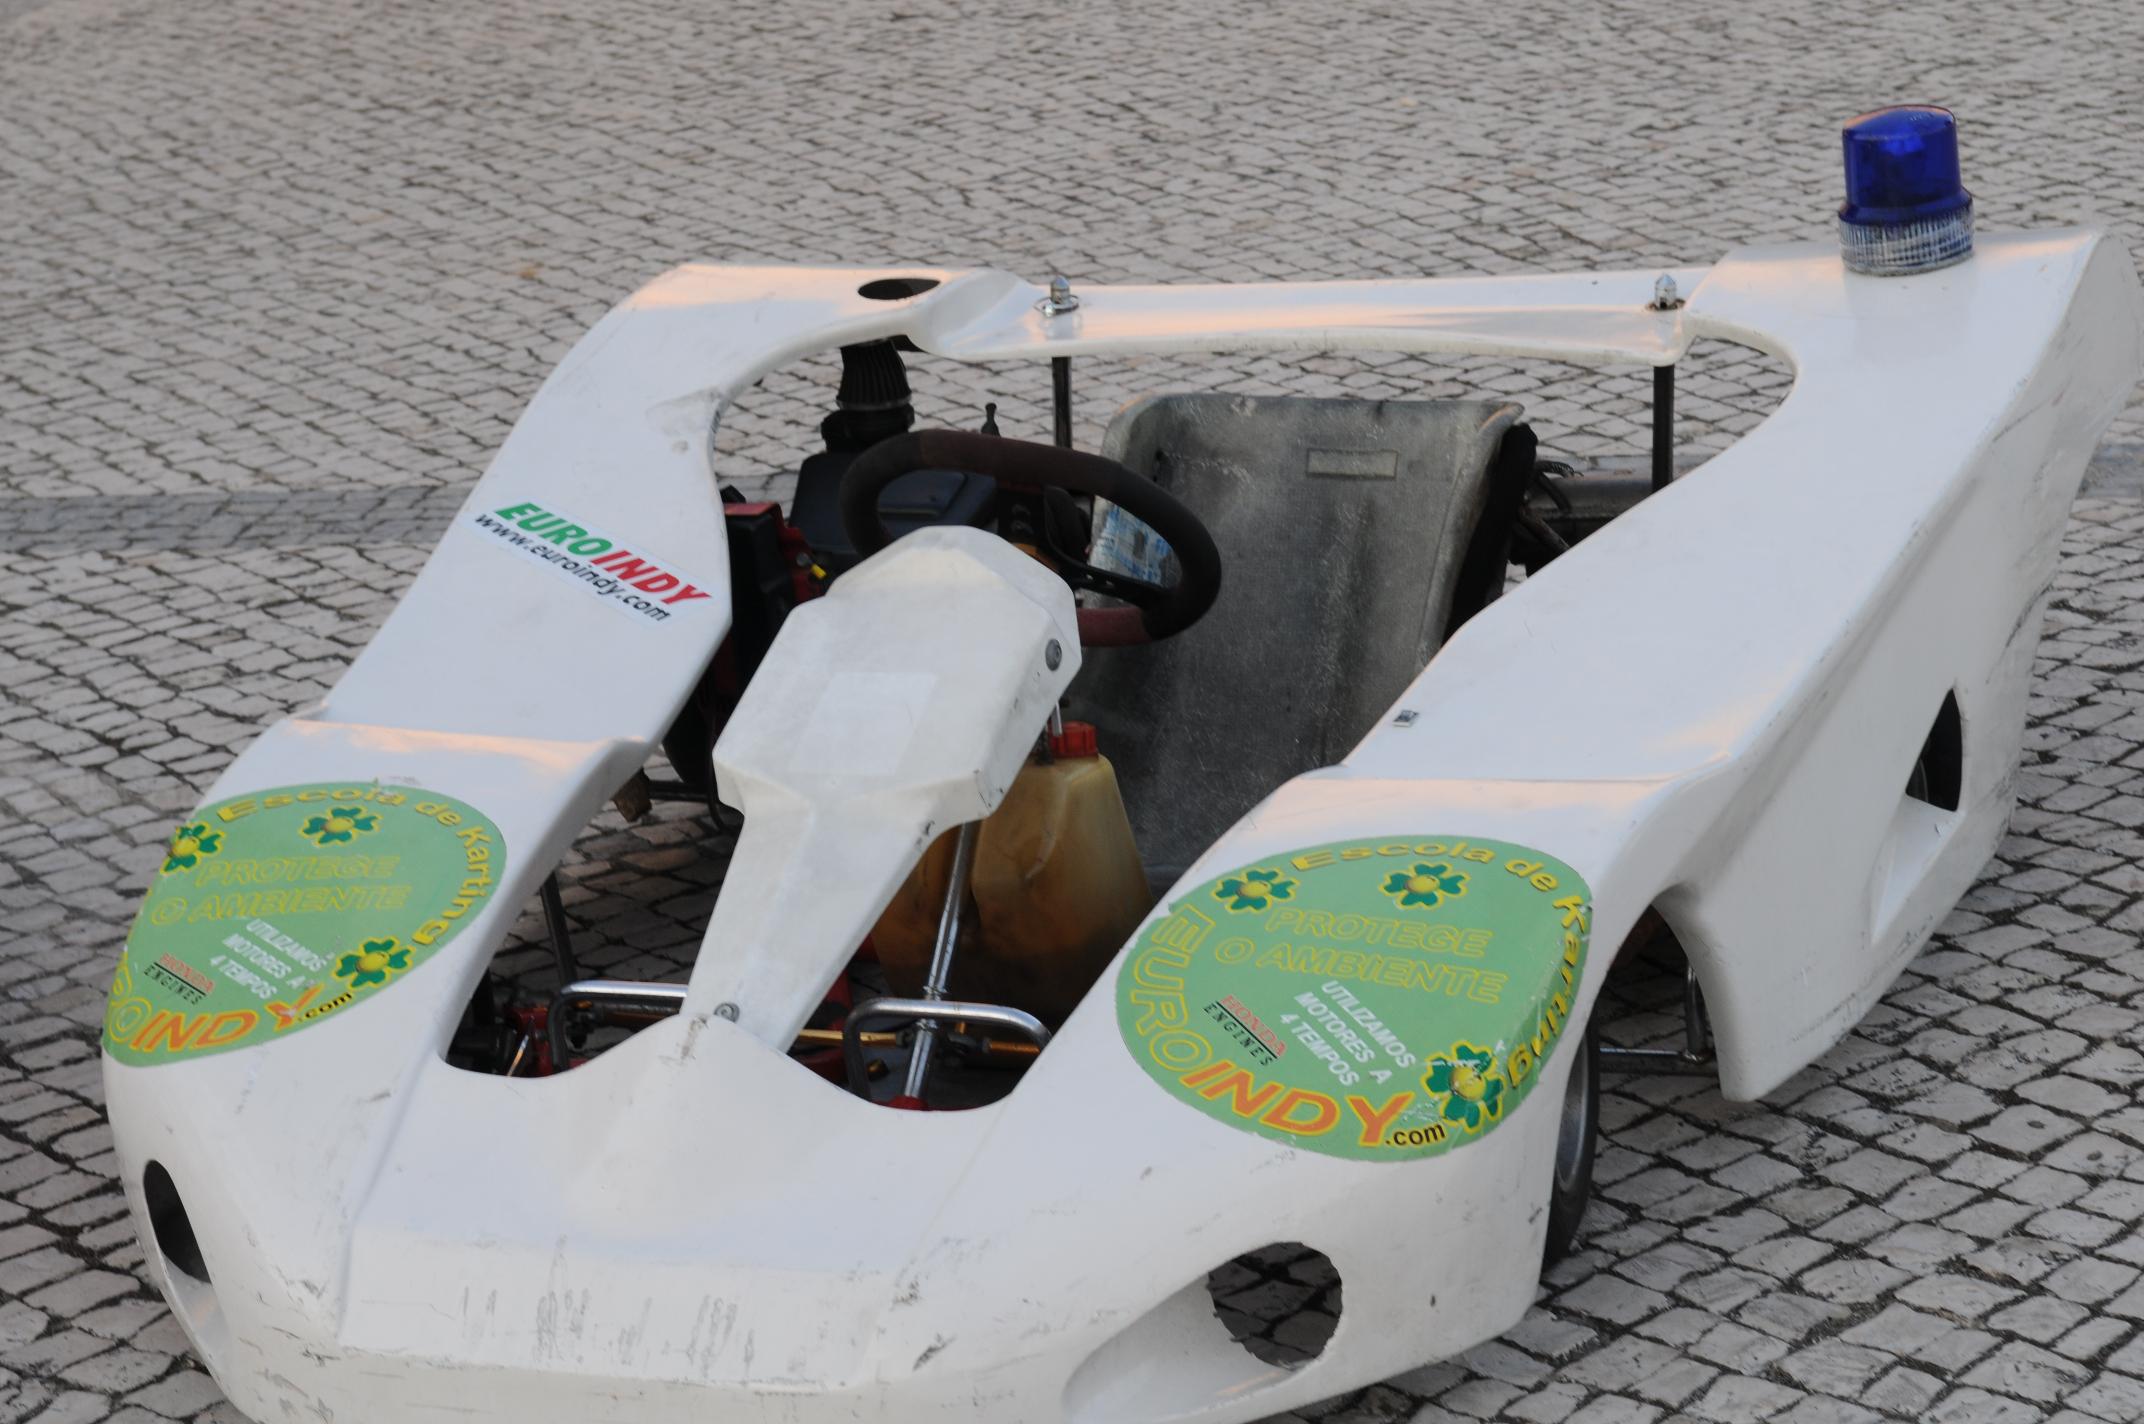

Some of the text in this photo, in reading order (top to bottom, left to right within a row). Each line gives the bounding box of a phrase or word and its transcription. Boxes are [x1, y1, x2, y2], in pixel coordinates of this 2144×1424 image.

[475, 514, 671, 621] www.euroindy.com
[195, 854, 402, 888] PROTEGE
[216, 786, 493, 945] Escola de Karting
[150, 885, 412, 926] O AMBIENTE
[1264, 906, 1496, 958] PROTEGE
[210, 954, 277, 999] 4 TEMPOS
[223, 933, 292, 979] MOTORES
[246, 918, 327, 972] UTILIZAMOS
[1215, 937, 1507, 1002] O AMBIENTE
[1290, 841, 1587, 1088] Escola de Karting
[1202, 1002, 1273, 1067] ENGINES
[1219, 994, 1287, 1057] HONDA
[1279, 1012, 1360, 1086] 4 TEMPOS
[1294, 991, 1393, 1084] MOTORES A
[1321, 980, 1416, 1068] UTILIZAMOS
